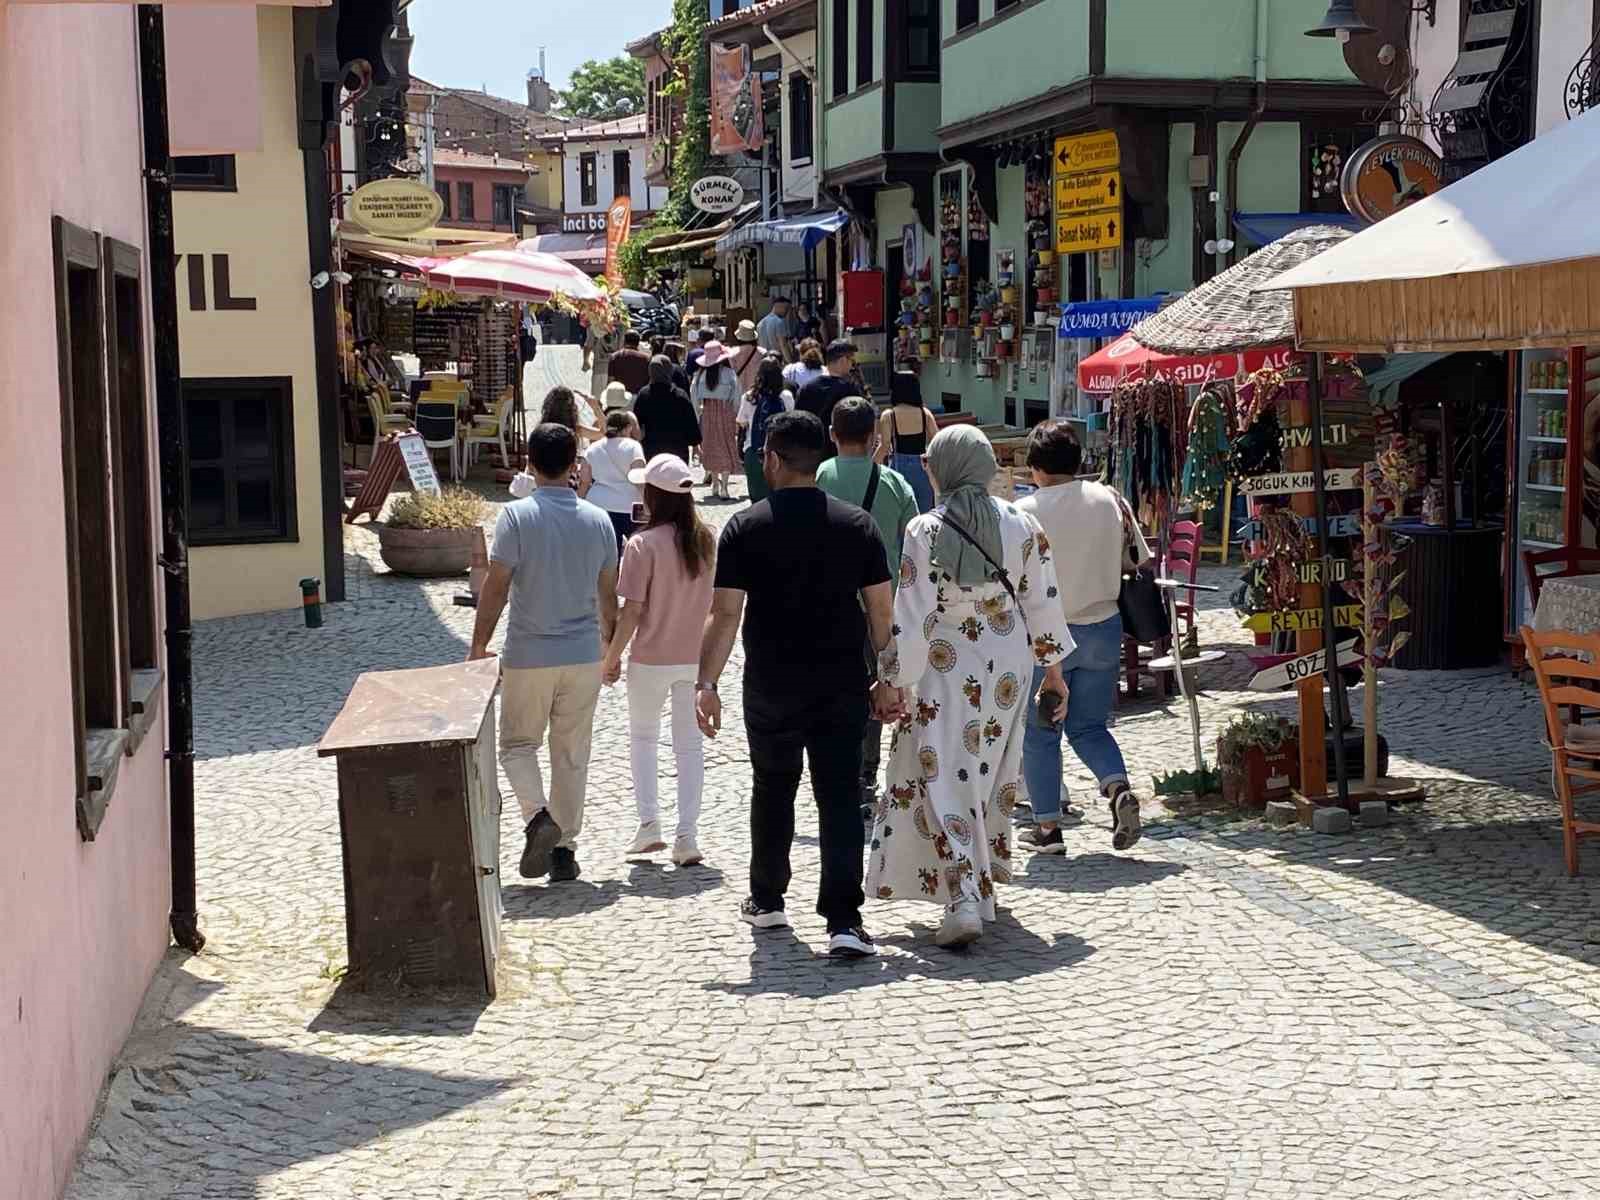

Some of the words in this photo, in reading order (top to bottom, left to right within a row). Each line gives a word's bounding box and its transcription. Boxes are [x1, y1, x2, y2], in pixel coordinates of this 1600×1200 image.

[701, 195, 733, 204] KONAK
[589, 213, 607, 231] bö
[1059, 224, 1078, 243] Sanat
[175, 253, 256, 311] IL
[1061, 311, 1107, 332] KUMDA
[1271, 607, 1350, 631] REYHN
